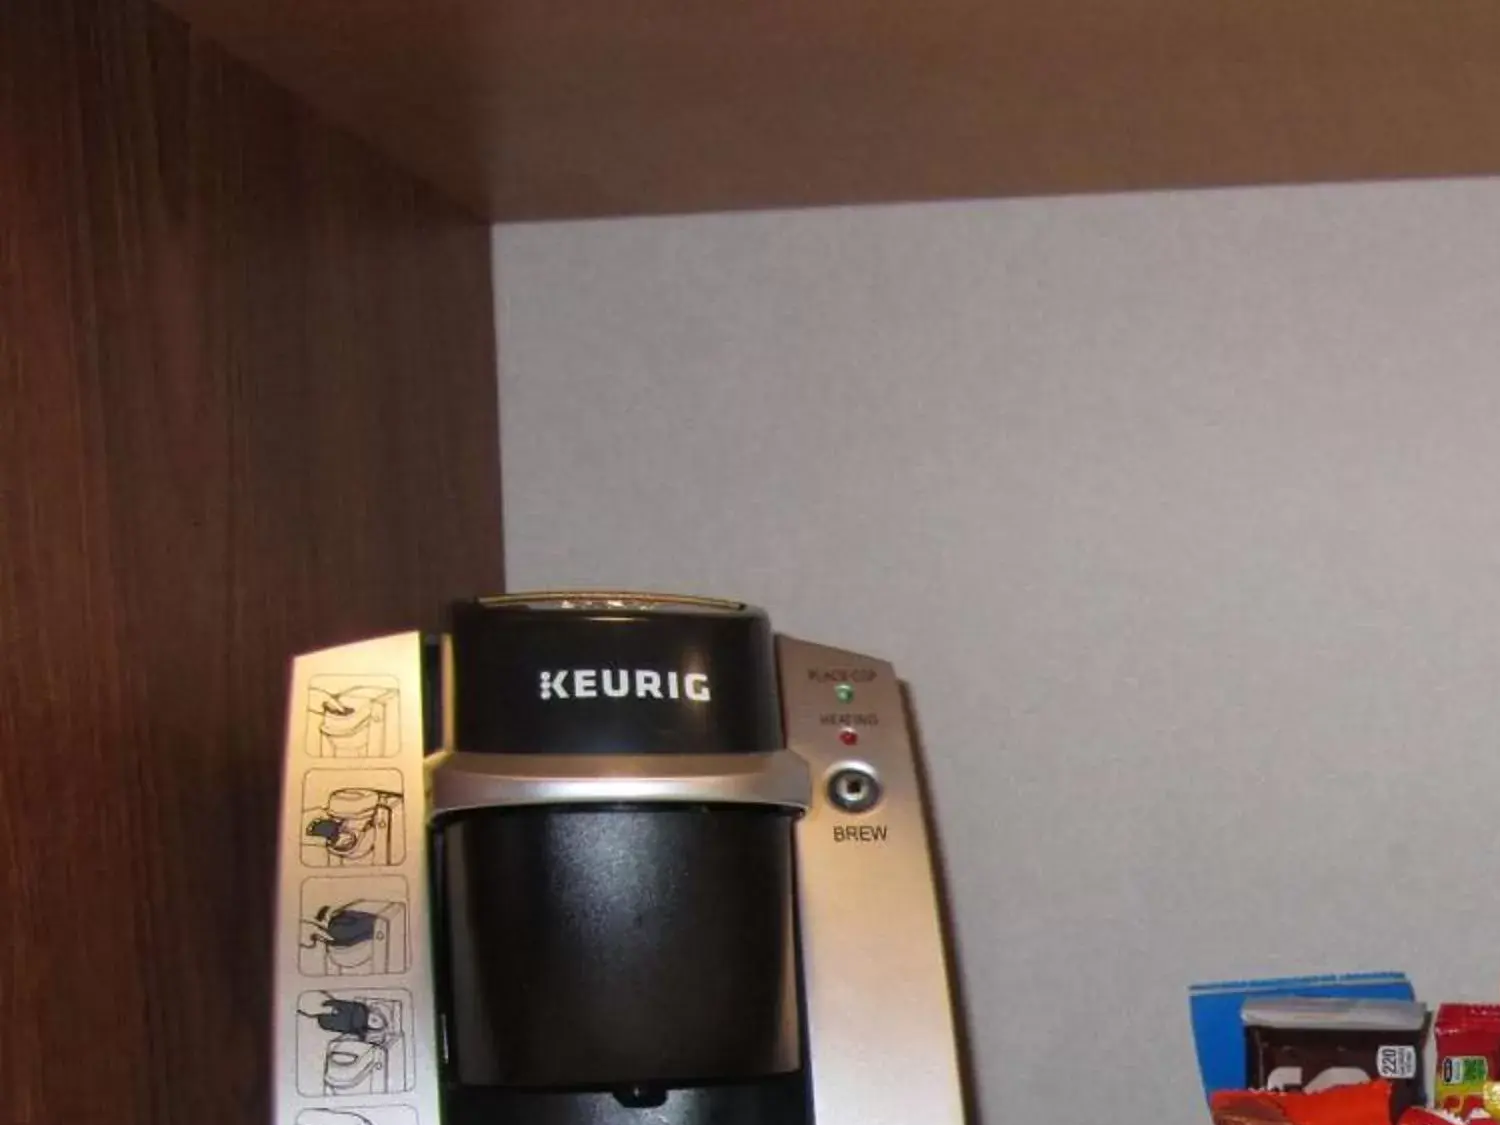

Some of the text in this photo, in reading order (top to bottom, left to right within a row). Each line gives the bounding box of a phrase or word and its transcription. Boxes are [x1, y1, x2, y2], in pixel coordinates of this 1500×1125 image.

[540, 669, 711, 701] KEURIG
[833, 825, 887, 842] BREW
[1382, 1048, 1397, 1076] 220
